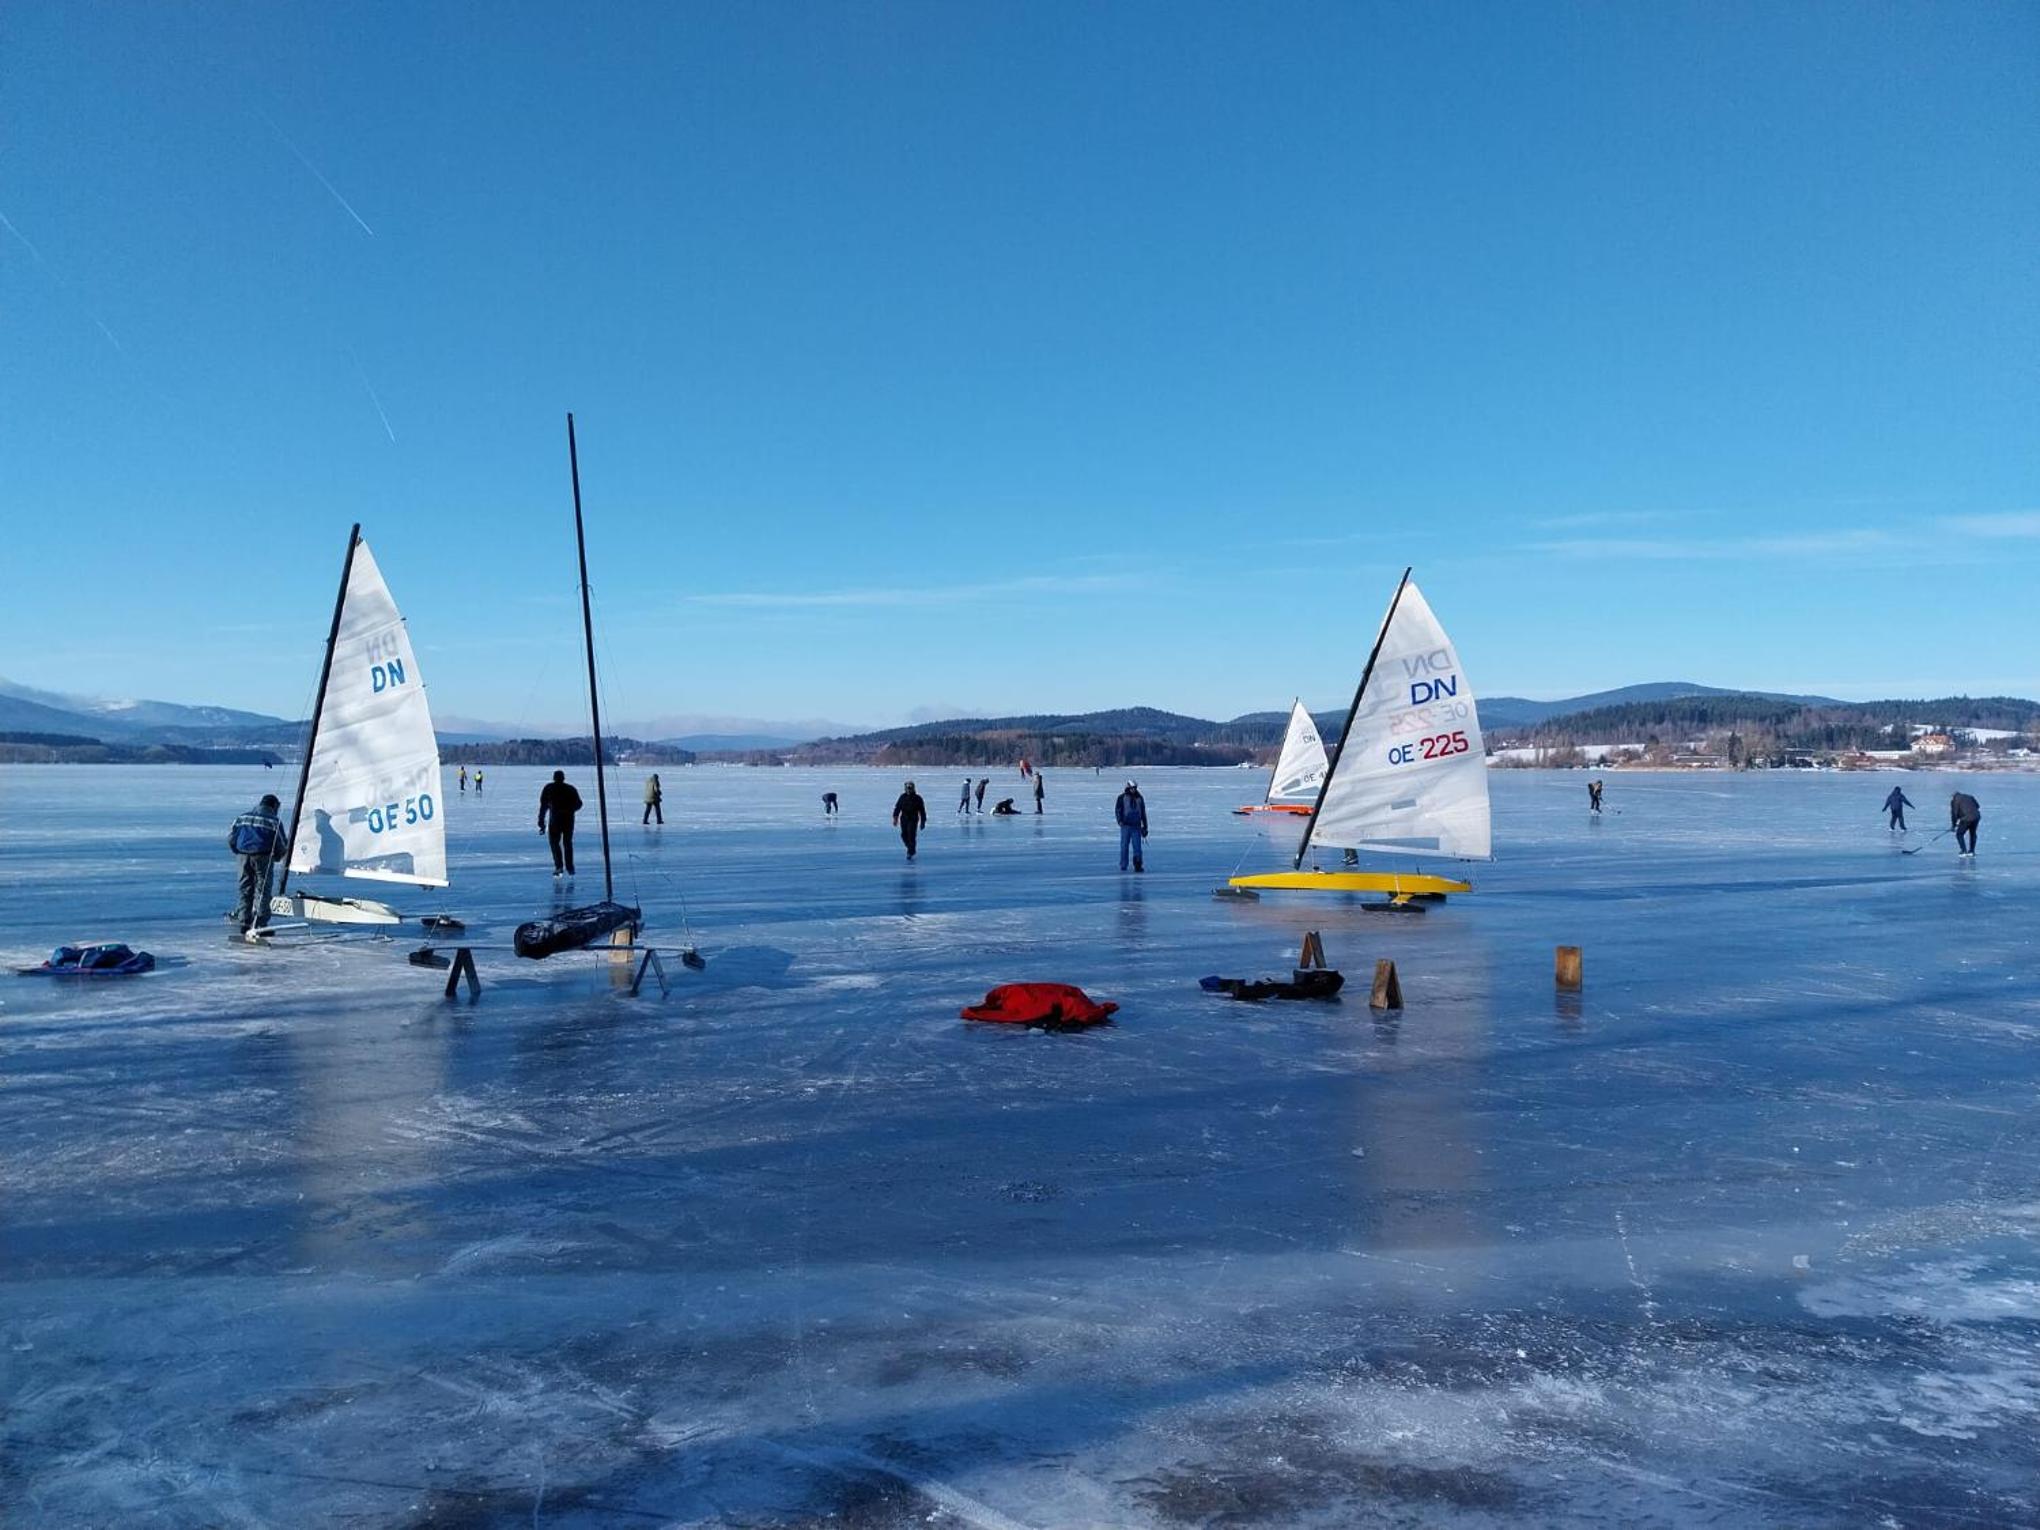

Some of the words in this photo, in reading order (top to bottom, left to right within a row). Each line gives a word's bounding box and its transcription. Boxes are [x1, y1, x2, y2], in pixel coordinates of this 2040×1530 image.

[371, 658, 406, 693] DN
[1411, 675, 1456, 705] DN
[1303, 735, 1316, 744] DN
[1388, 744, 1414, 764] OE
[1304, 773, 1317, 783] OE
[368, 803, 399, 833] OE
[406, 794, 434, 825] 50
